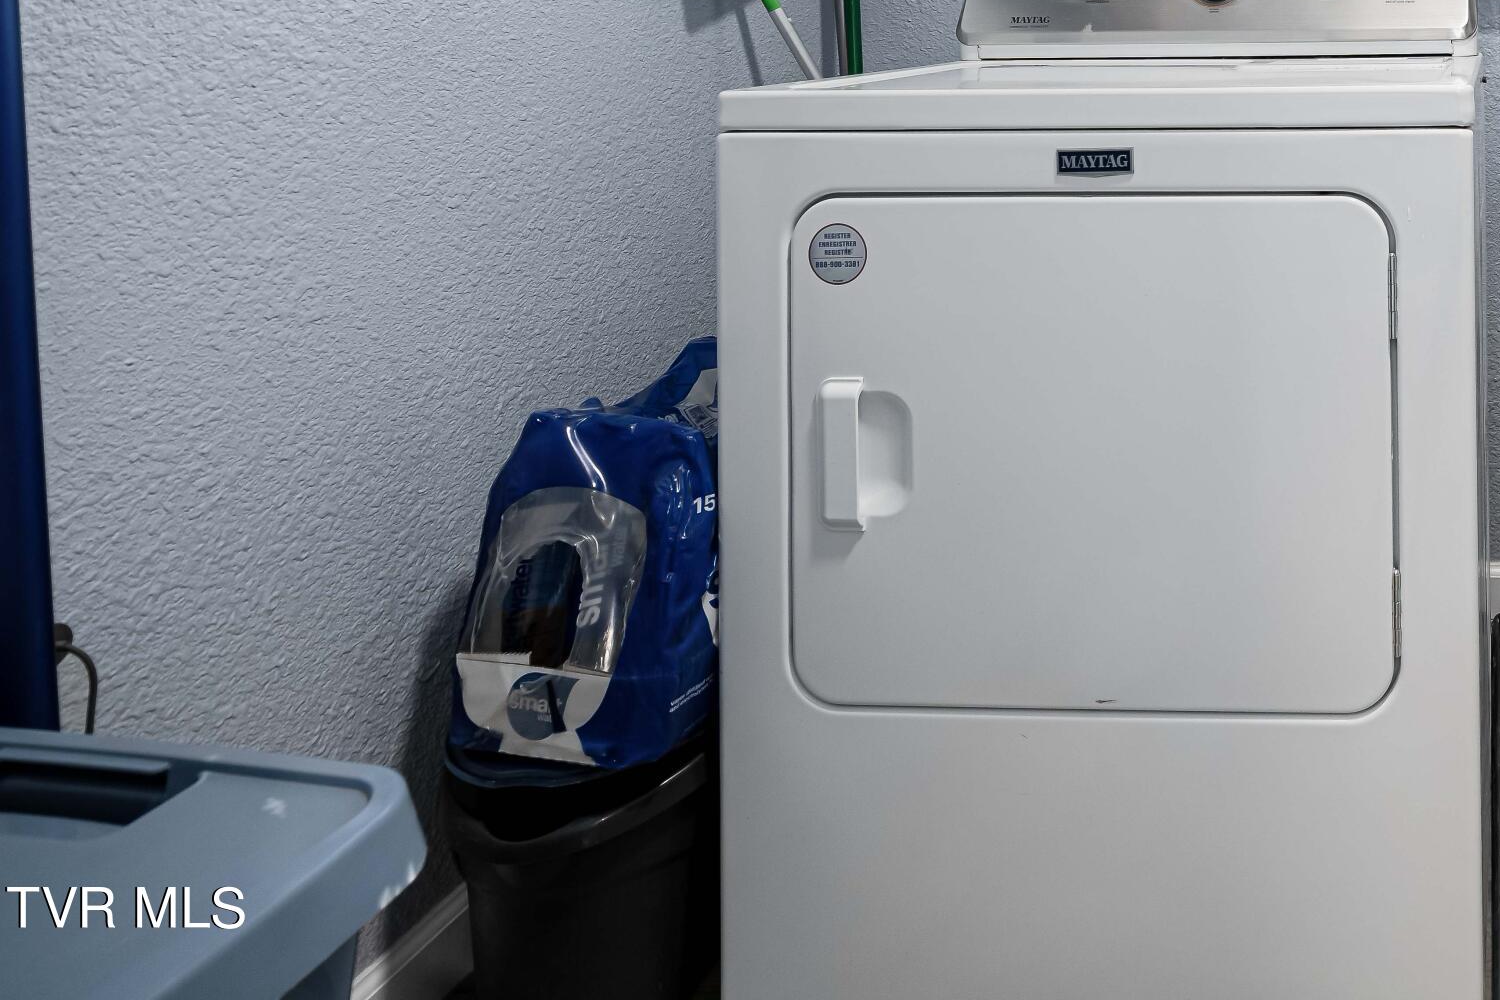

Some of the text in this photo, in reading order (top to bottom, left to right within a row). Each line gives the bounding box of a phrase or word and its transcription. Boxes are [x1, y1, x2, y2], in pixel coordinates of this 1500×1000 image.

[1010, 16, 1050, 24] MAYTAG
[1061, 154, 1128, 169] MAYTAG
[693, 493, 716, 514] 15
